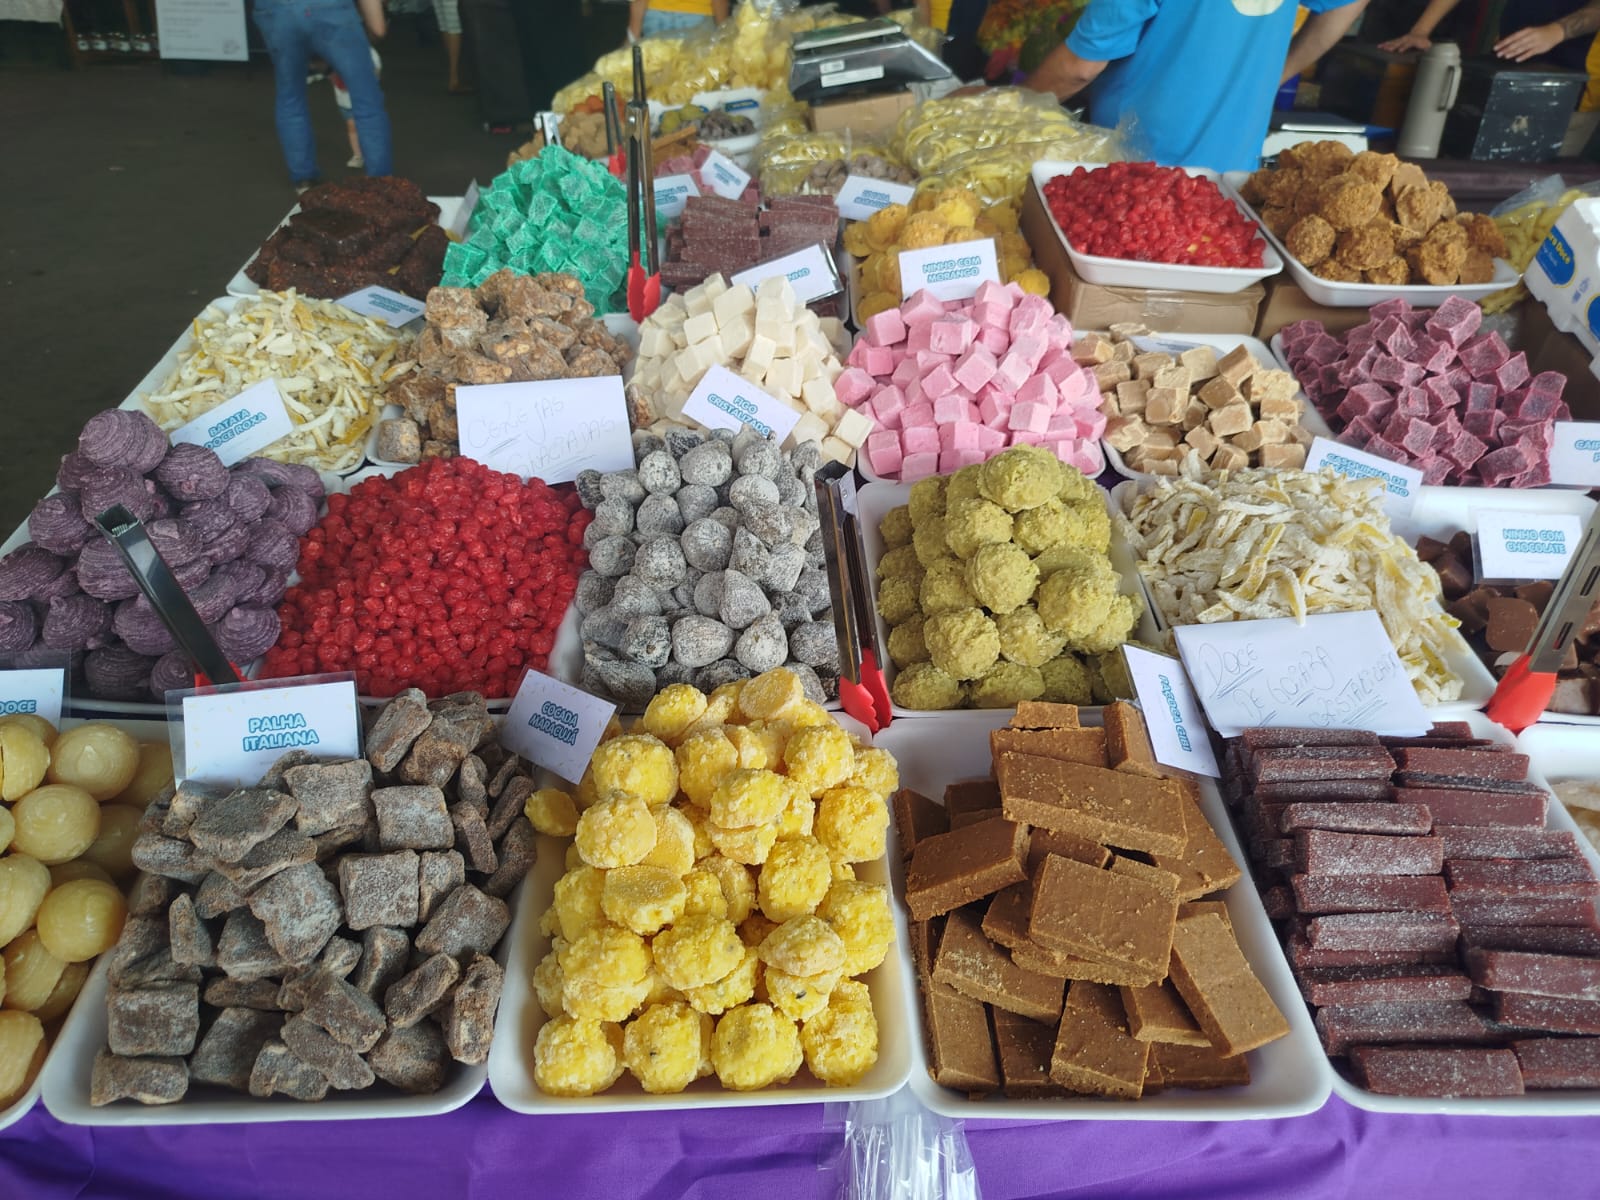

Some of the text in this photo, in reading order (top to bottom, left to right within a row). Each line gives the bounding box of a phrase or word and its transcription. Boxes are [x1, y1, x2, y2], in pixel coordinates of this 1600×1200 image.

[922, 256, 981, 273] NINHO COM
[926, 266, 980, 284] MORANGO
[707, 393, 771, 437] CRISTALIZADO
[733, 395, 759, 415] FIGO
[203, 411, 267, 449] DOCE ROXA
[208, 408, 250, 437] BATATA
[1327, 453, 1391, 482] CASQUINHA
[1391, 475, 1408, 488] DE
[1502, 528, 1565, 542] NINHO COM
[1505, 541, 1567, 554] CHOCOLATE
[1198, 642, 1258, 699] DOCE
[248, 712, 306, 734] PALHA
[541, 701, 579, 728] COCADA
[242, 729, 320, 752] ITALIANA
[528, 713, 579, 746] MARACUJÁ
